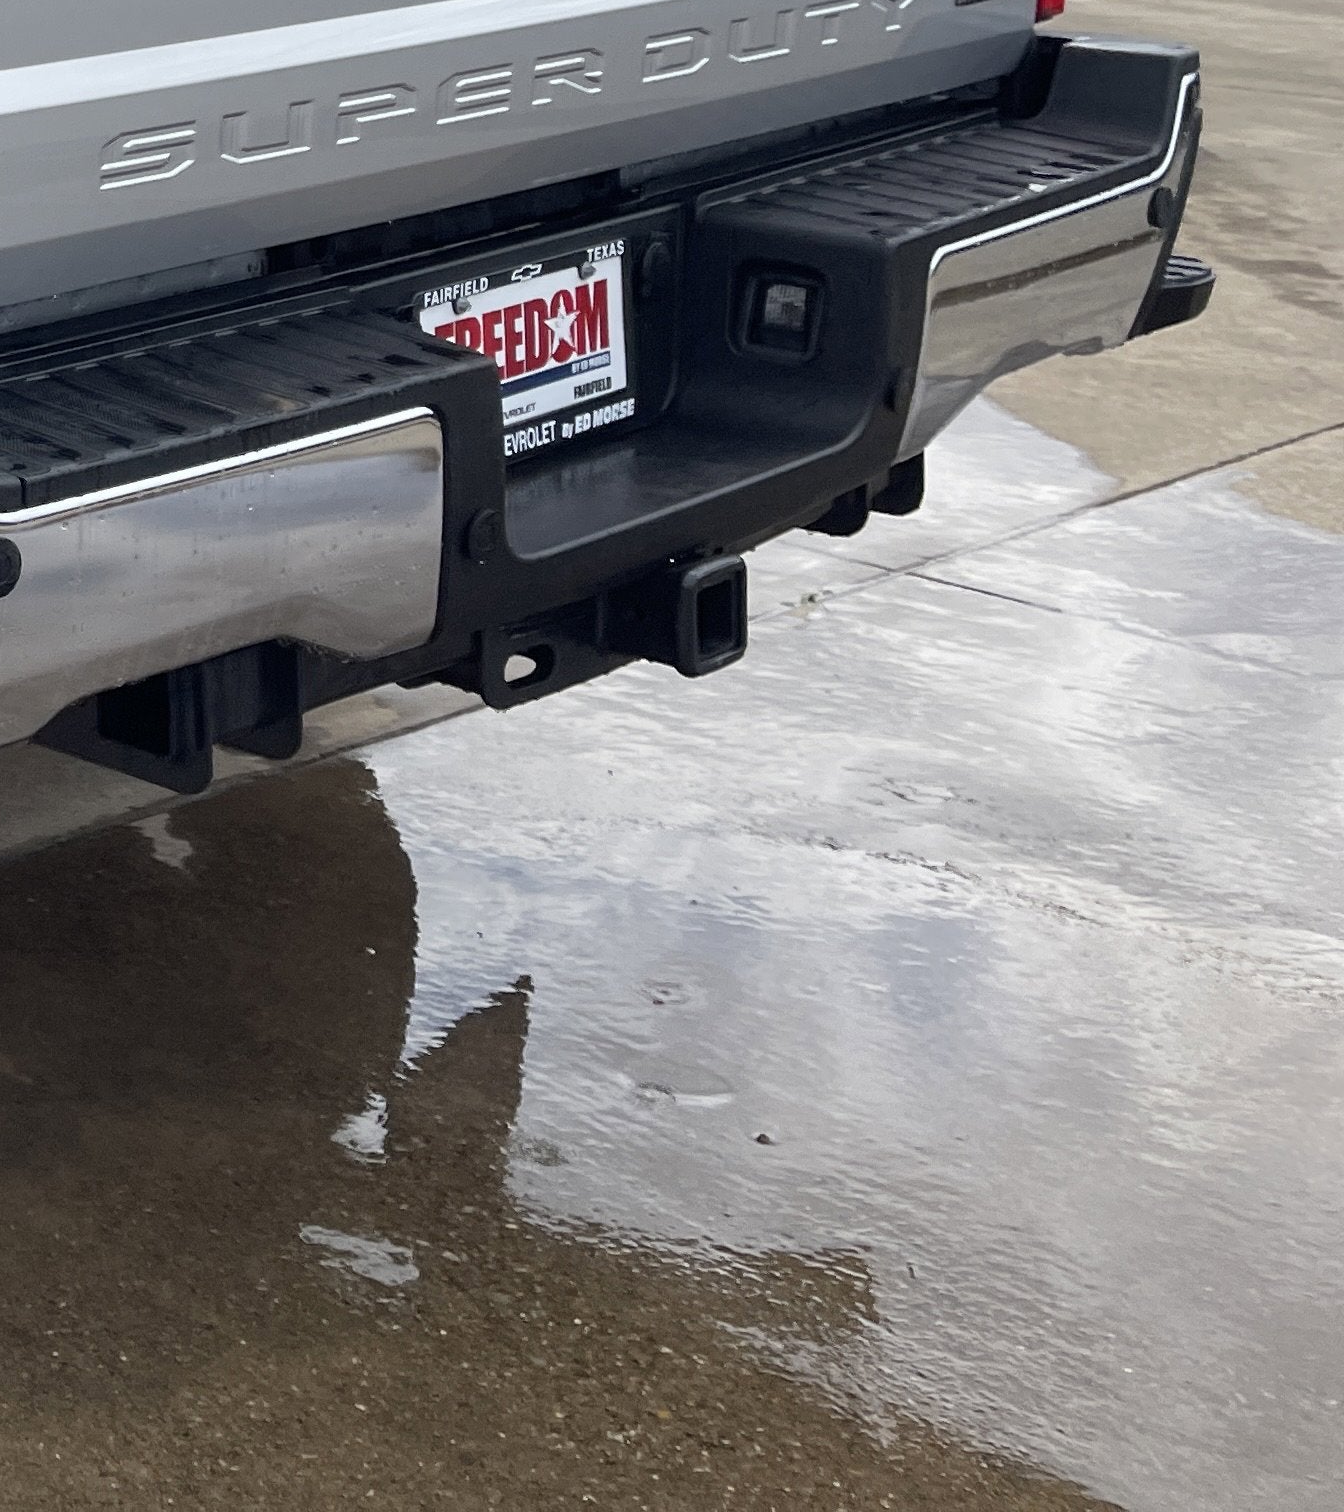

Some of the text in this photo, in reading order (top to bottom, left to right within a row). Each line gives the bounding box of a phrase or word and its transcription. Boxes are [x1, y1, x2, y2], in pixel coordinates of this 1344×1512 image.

[100, 46, 604, 190] SUPER
[423, 240, 625, 308] FAIRFIELD TEXAS
[504, 420, 556, 457] EVROLET
[574, 413, 592, 434] ED
[592, 398, 635, 428] MORSE
